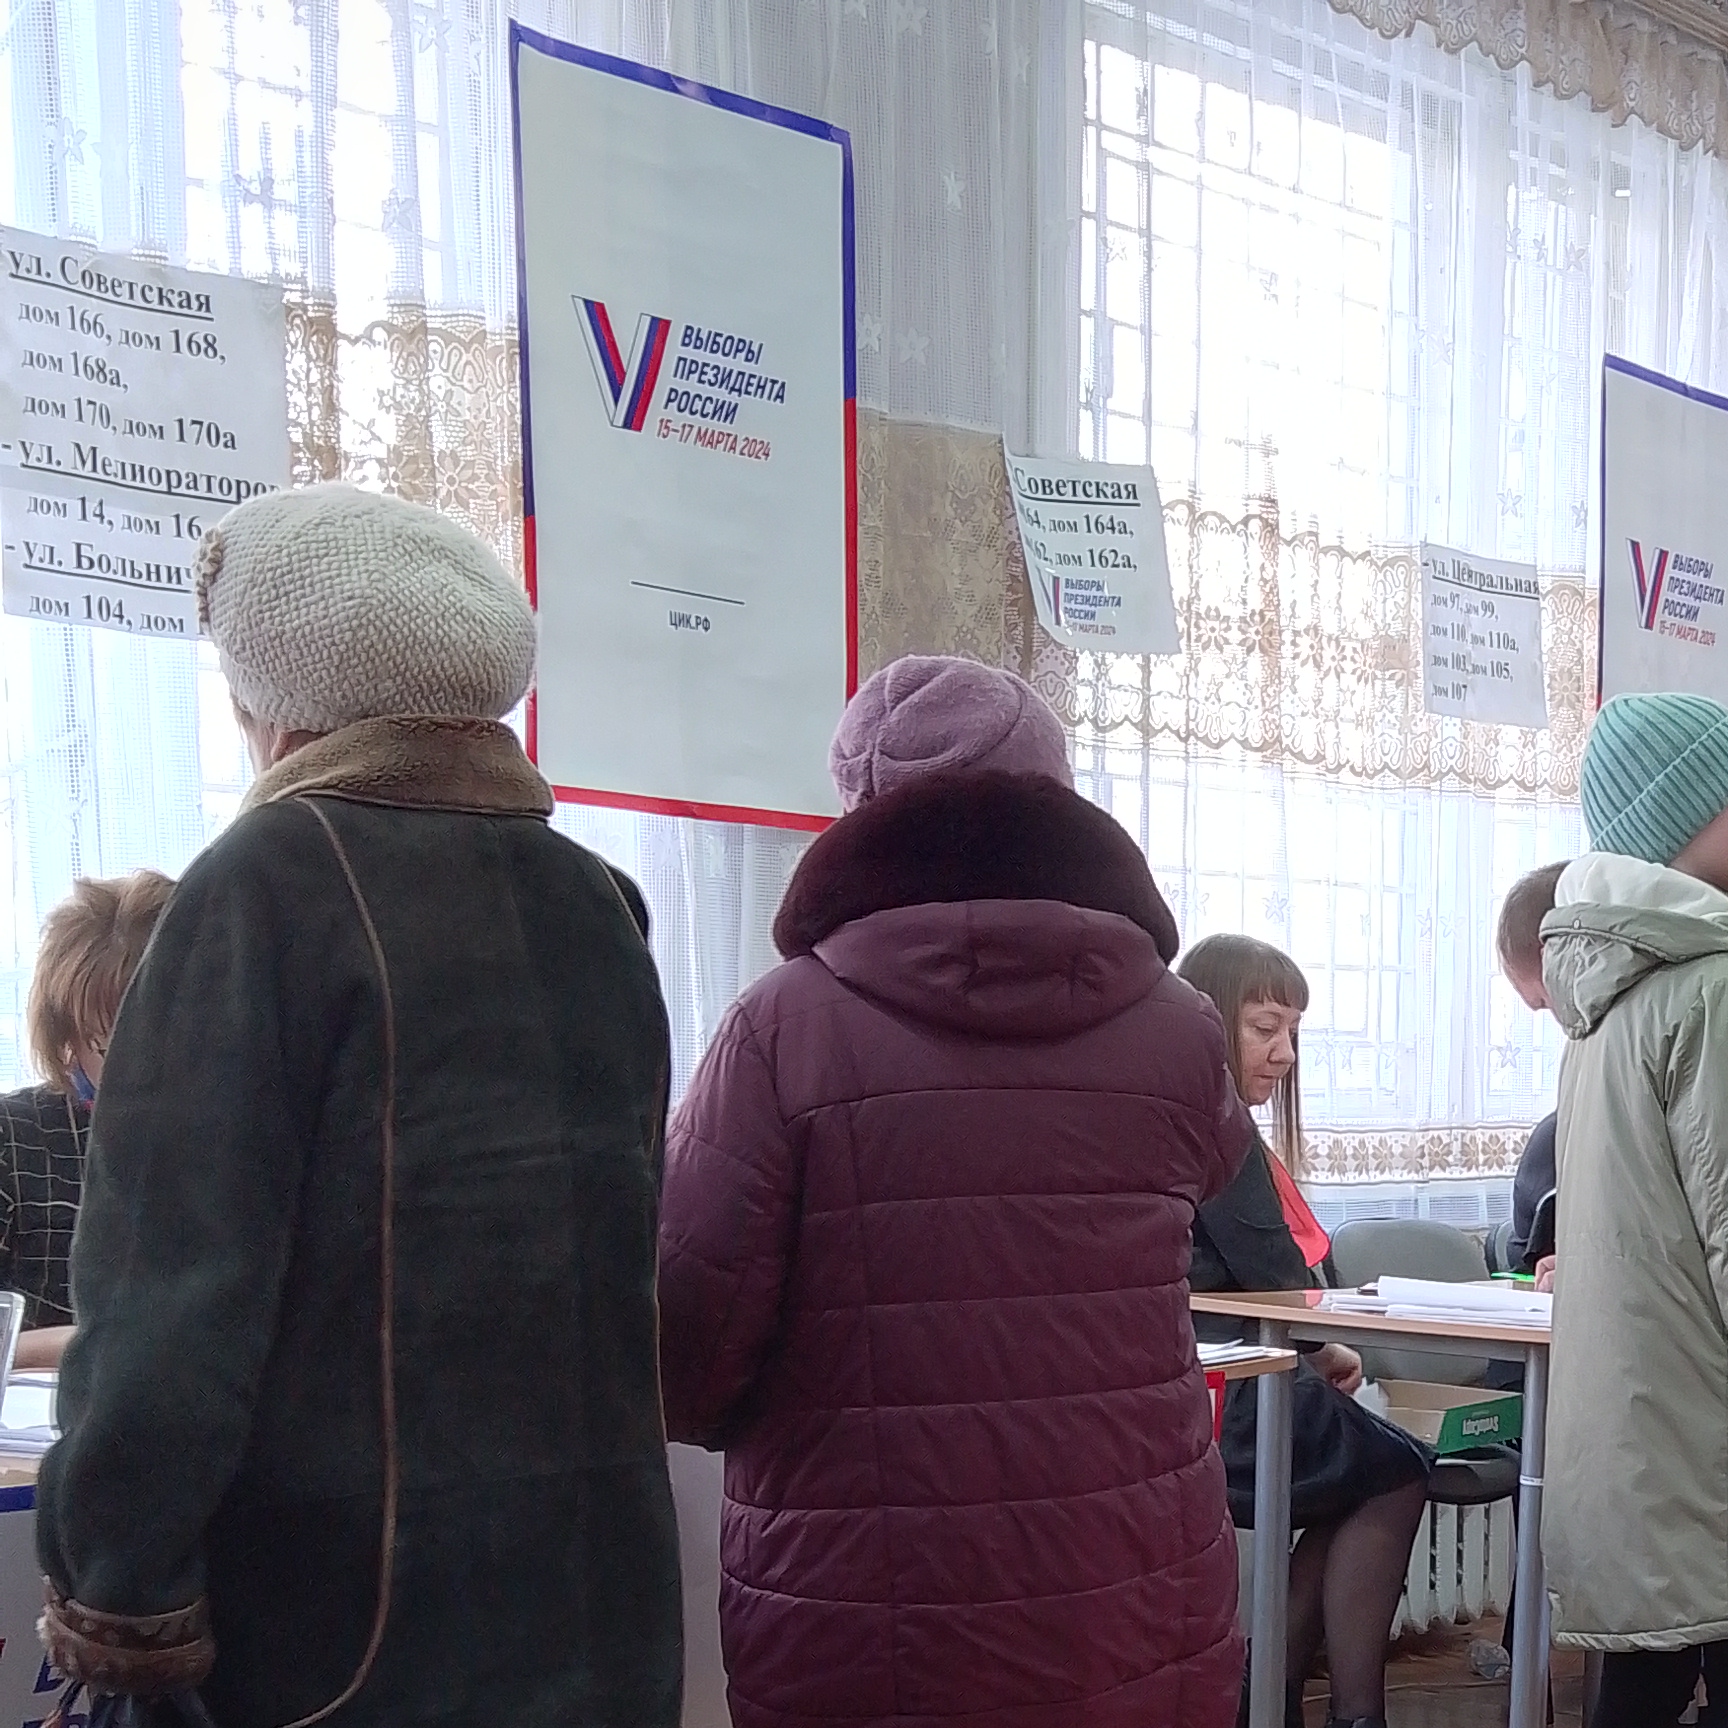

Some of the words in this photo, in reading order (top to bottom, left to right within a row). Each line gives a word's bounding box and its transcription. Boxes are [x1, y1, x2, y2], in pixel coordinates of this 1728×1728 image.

[7, 248, 51, 279] ул.
[60, 255, 214, 315] Советская
[18, 302, 60, 327] дом
[67, 305, 112, 346] 166,
[118, 325, 161, 352] дом
[170, 328, 226, 365] 168,
[681, 325, 763, 365] ВЫБОРЫ
[22, 348, 64, 374] дом
[70, 350, 129, 393] 168а,
[673, 356, 786, 404] ПРЕЗИДЕНТА
[664, 387, 739, 425] РОССИИ
[23, 394, 67, 420] дом
[74, 397, 117, 435] 170,
[122, 415, 165, 441] дом
[175, 418, 237, 451] 170а
[18, 440, 62, 467] ул.
[695, 425, 738, 454] МАРТА
[739, 436, 771, 461] 2024
[1013, 467, 1138, 500] Советская
[27, 496, 68, 518] дом
[77, 496, 115, 532] 14,
[120, 513, 161, 535] дом
[1049, 518, 1078, 534] дом
[1083, 513, 1134, 538] 164а,
[23, 541, 63, 567] ул.
[1054, 553, 1082, 567] дом
[1088, 548, 1138, 572] 162а,
[1431, 558, 1449, 578] ул.
[1671, 553, 1714, 579] ВЫБОРЫ
[1064, 578, 1105, 592] ВЫБОРЫ
[1667, 576, 1725, 606] ПРЕЗИДЕНТА
[29, 595, 70, 618] дом
[82, 595, 133, 628] 104,
[140, 613, 185, 633] дом
[1063, 592, 1122, 608] ПРЕЗИДЕНТА
[1431, 594, 1448, 608] дом
[1480, 600, 1499, 622] 99,
[1662, 598, 1700, 622] РОССИИ
[669, 610, 711, 633] ЦИК.РФ
[1675, 624, 1699, 643] МАРТА
[1430, 624, 1448, 637] дом
[1488, 631, 1519, 653] 110а,
[1431, 654, 1448, 668] дом
[1490, 660, 1513, 683] 105,
[1432, 683, 1448, 698] дом
[1451, 681, 1467, 702] 107
